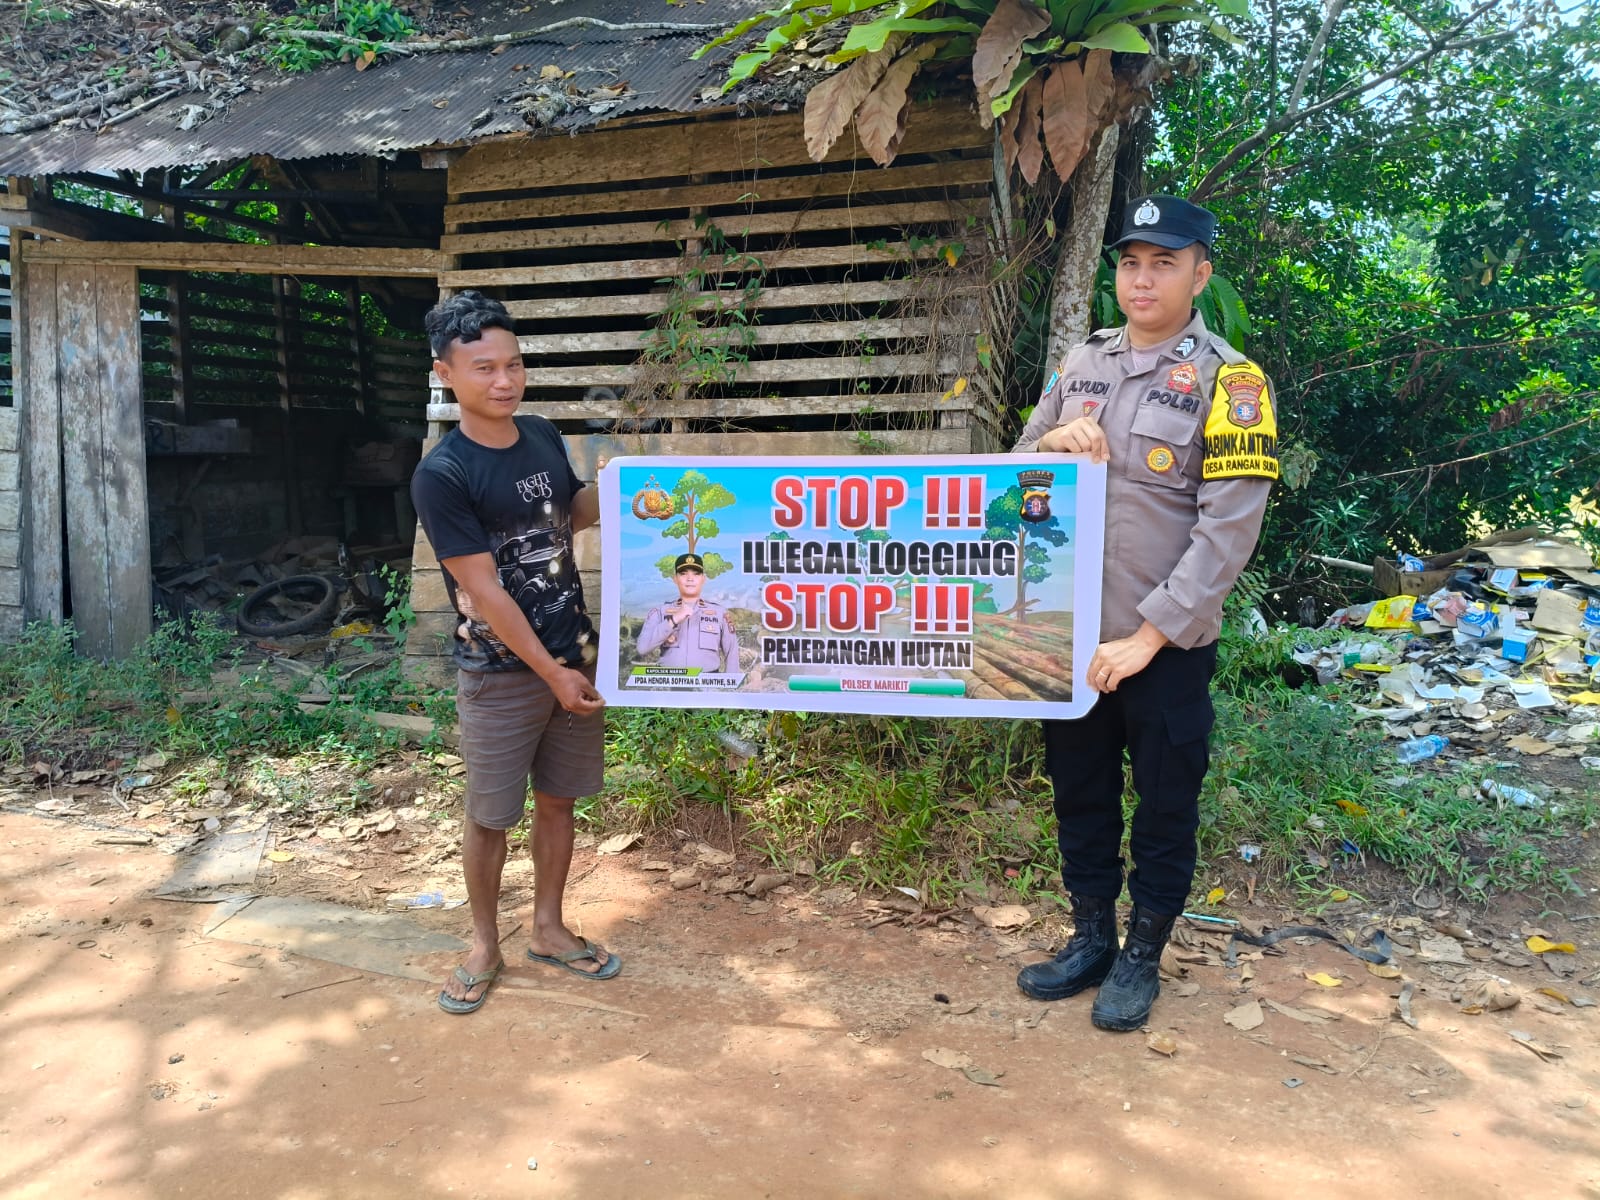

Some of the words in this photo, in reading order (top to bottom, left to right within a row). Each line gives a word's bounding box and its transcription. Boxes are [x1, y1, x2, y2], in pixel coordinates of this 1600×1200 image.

[1146, 389, 1201, 414] POLRI
[1205, 461, 1224, 474] DESA
[1225, 459, 1260, 472] RANGAN
[515, 471, 552, 493] FIGHT
[774, 477, 906, 529] STOP
[925, 476, 982, 528] !!!
[743, 541, 861, 575] ILLEGAL
[869, 541, 1016, 576] LOGGING
[764, 583, 893, 631] STOP
[914, 585, 970, 632] !!!
[763, 638, 896, 666] PENEBANGAN
[901, 640, 972, 668] HUTAN
[634, 677, 648, 685] IPDA
[648, 677, 670, 685] HENDRA
[841, 679, 873, 690] POLSEK
[874, 680, 910, 691] MARIKIT
